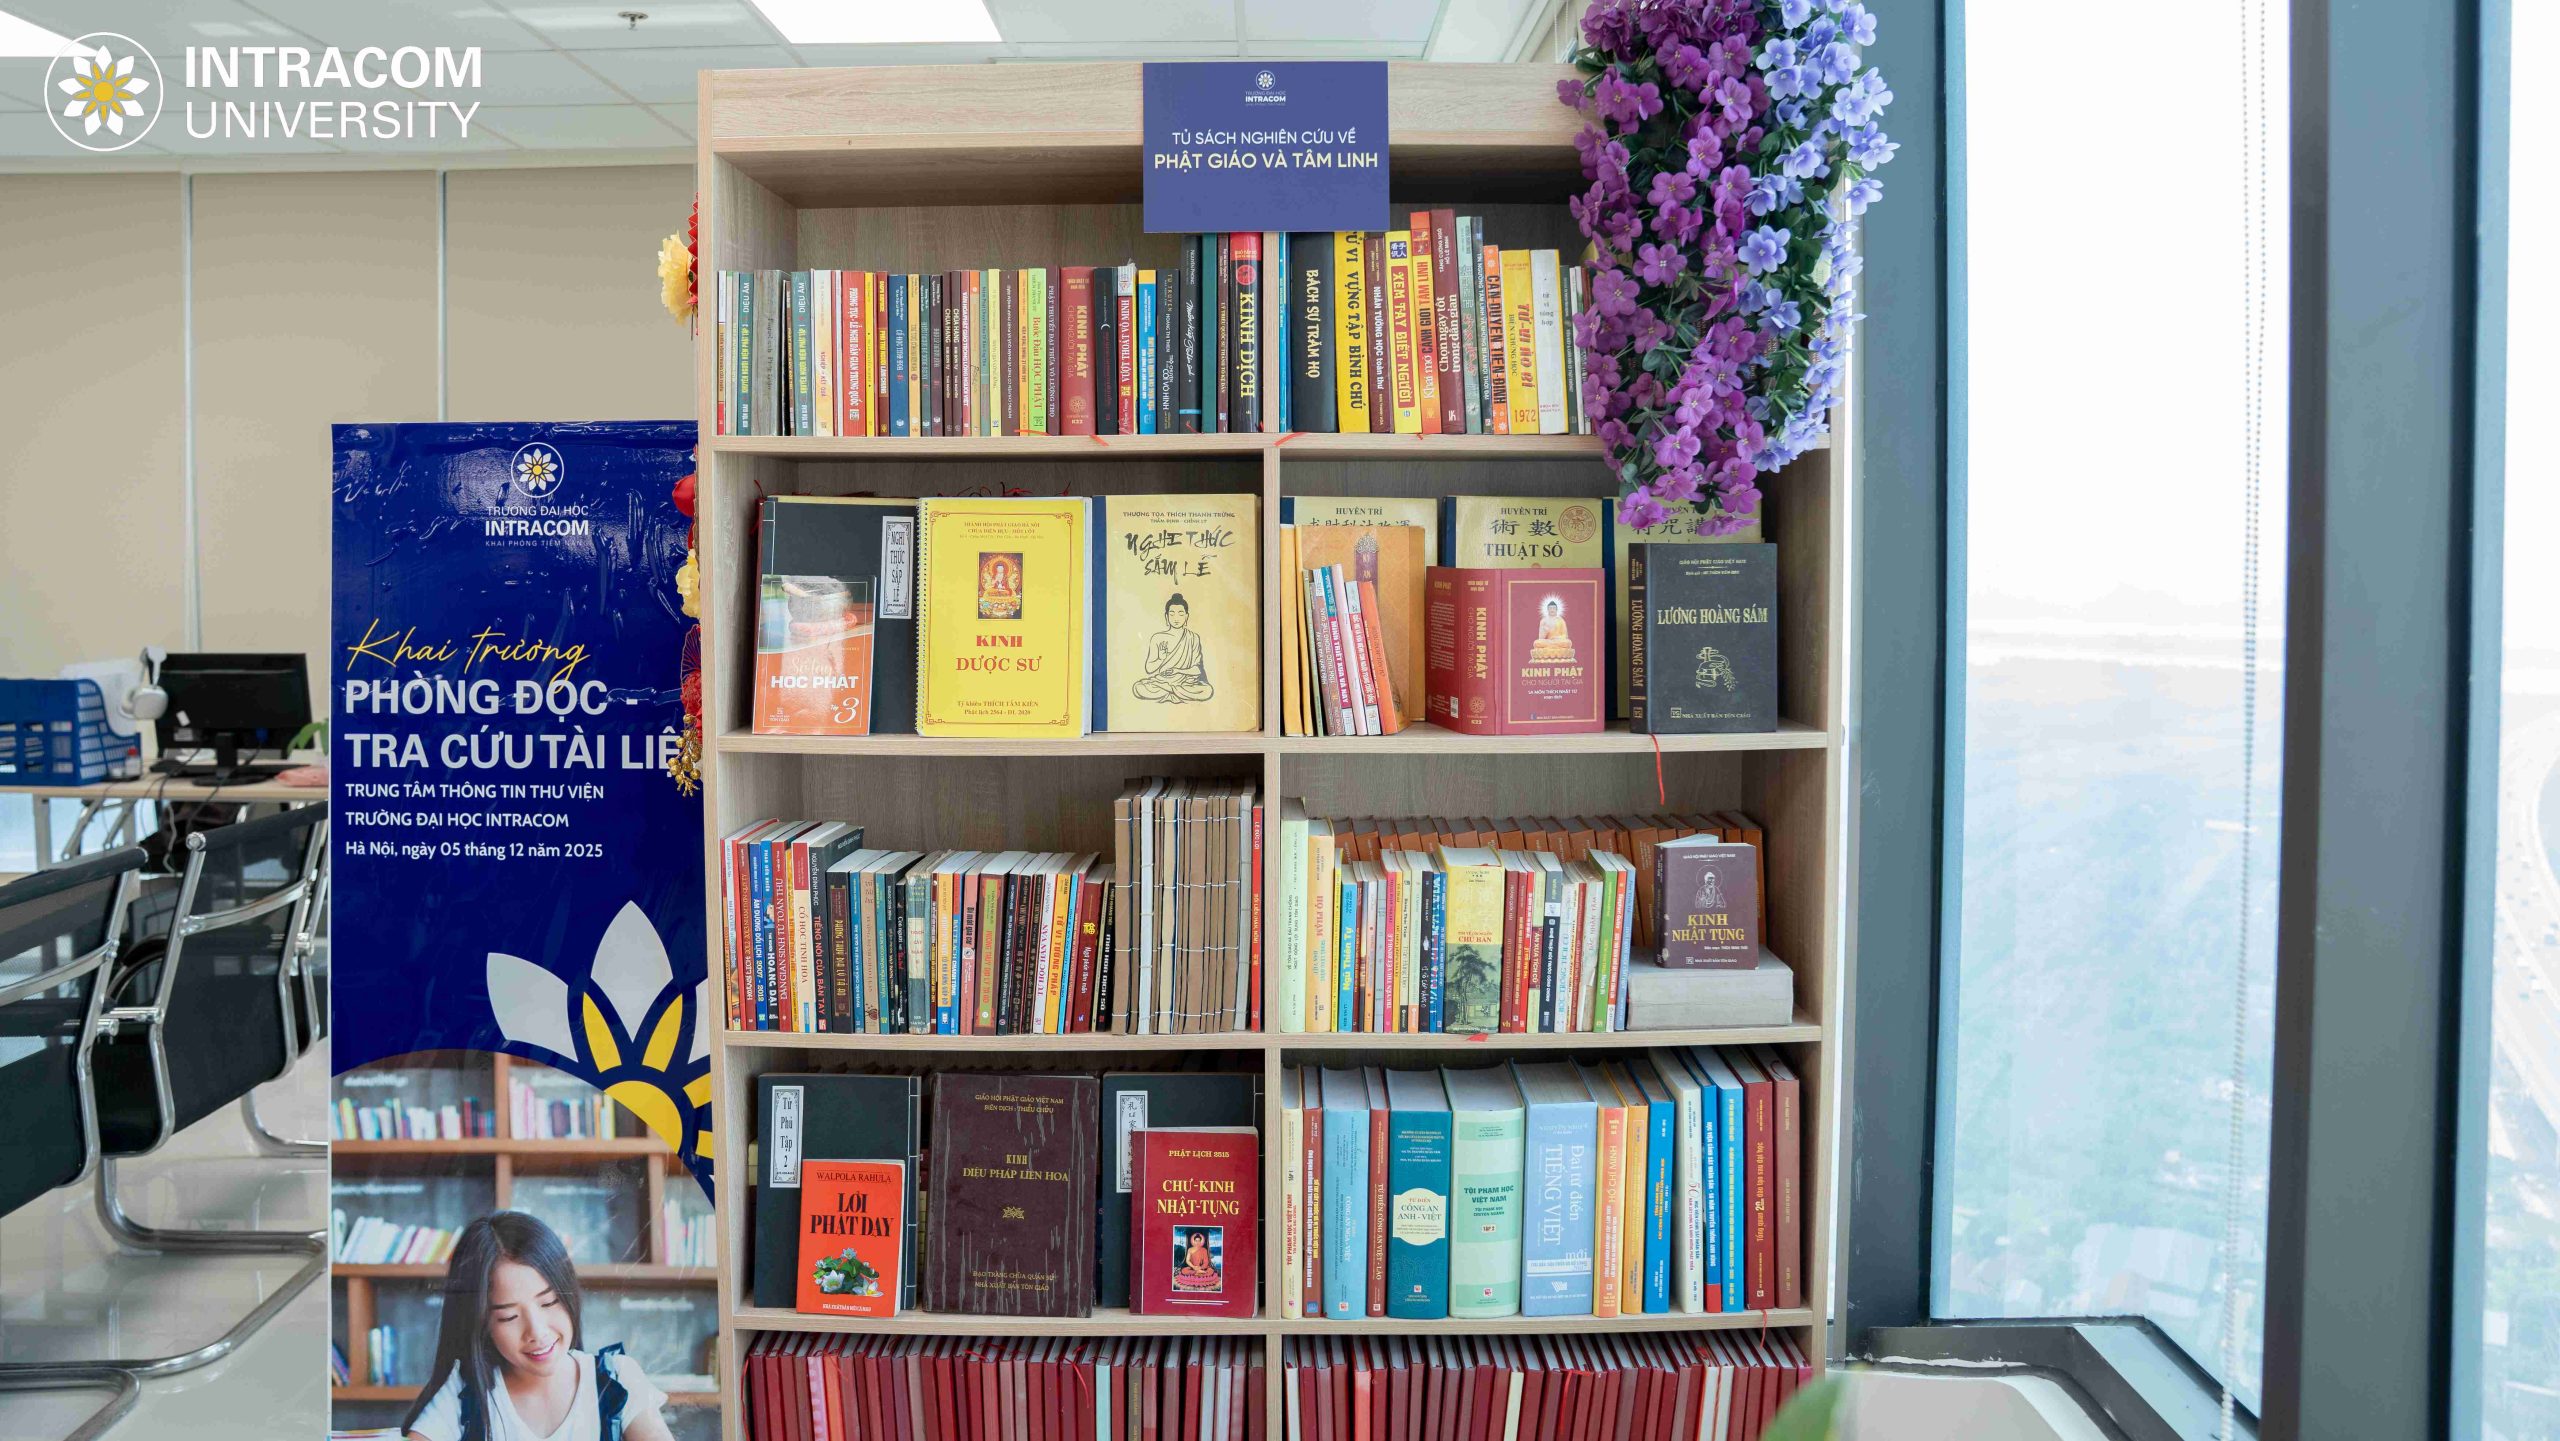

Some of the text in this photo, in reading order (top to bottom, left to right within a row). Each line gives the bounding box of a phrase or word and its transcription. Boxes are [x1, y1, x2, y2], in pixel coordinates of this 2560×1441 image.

[1172, 127, 1356, 144] TỦ SÁCH NGHIÊN CỨU VỀ
[1154, 149, 1378, 172] PHẬT GIÁO VÀ TÂM LINH
[1067, 305, 1075, 322] CHO
[1305, 270, 1322, 378] BÁCH SỰ TRĂM HỌ
[1448, 294, 1462, 372] trong dân gian
[1067, 326, 1076, 349] NGƯỜI
[1073, 305, 1089, 378] KINH PHẬT
[1393, 272, 1414, 402] XEM TAY BIẾT NGƯỜI
[1436, 297, 1449, 372] Chọn ngày tốt
[1236, 292, 1255, 398] KINH DỊCH
[1066, 351, 1075, 363] TẠI
[1423, 375, 1435, 399] Khai
[1514, 408, 1537, 423] 1972
[487, 504, 588, 518] TRƯỜNG ĐẠI HỌC
[485, 520, 589, 536] INTRACOM
[1125, 525, 1236, 561] NGHI THỨC
[1484, 541, 1563, 561] THUẬT SỐ
[1700, 604, 1740, 624] HOÀNG
[1743, 603, 1768, 623] SÁM
[347, 618, 457, 672] Khai
[976, 635, 1022, 647] KINH
[1467, 626, 1475, 651] NGƯỜI
[1474, 607, 1488, 679] KINH PHẬT
[956, 655, 1042, 674] DƯỢC SƯ
[1522, 666, 1583, 678] KINH PHẬT
[771, 674, 858, 691] HỌC PHẬT
[346, 670, 499, 715] PHÒNG
[515, 679, 607, 722] ĐỌC
[345, 725, 694, 777] TRA CỨU TÀI LIỆ
[346, 782, 604, 802] TRUNG TÂM THÔNG TIN THƯ VIỆN
[346, 810, 569, 830] TRƯỜNG ĐẠI HỌC INTRACOM
[346, 842, 603, 861] Hà Nội, ngày 05 tháng 12 năm 2025
[814, 915, 824, 941] TIẾNG
[1688, 914, 1728, 926] KINH
[797, 906, 808, 983] CỔ HỌC TINH HOA
[1672, 926, 1744, 944] NHẬT TỤNG
[780, 1135, 793, 1153] Tập
[1169, 1149, 1191, 1158] PHẬT
[784, 1155, 788, 1167] 2
[1006, 1154, 1028, 1165] KINH
[1569, 1144, 1584, 1169] Đại
[1608, 1145, 1617, 1169] MINH
[816, 1172, 891, 1183] WALPOLA RAHULA
[963, 1167, 987, 1178] DIỆU
[990, 1167, 1017, 1179] PHÁP
[1045, 1172, 1068, 1181] HOA
[1163, 1178, 1234, 1193] CHƯ-KINH
[1464, 1185, 1514, 1195] TỘI PHẠM HỌC
[1543, 1144, 1567, 1246] TIẾNG VIỆT
[837, 1191, 867, 1214] LỜI
[1157, 1195, 1239, 1217] NHẬT-TỤNG
[1472, 1195, 1488, 1203] VIỆT
[1569, 1191, 1583, 1221] điển
[1607, 1189, 1616, 1203] HỒ
[1401, 1204, 1427, 1212] CÔNG
[1423, 1212, 1441, 1221] VIỆT
[811, 1213, 894, 1239] PHẬT DẠY
[1376, 1213, 1384, 1233] CÔNG
[1376, 1235, 1383, 1243] AN
[1375, 1245, 1383, 1261] VIỆT
